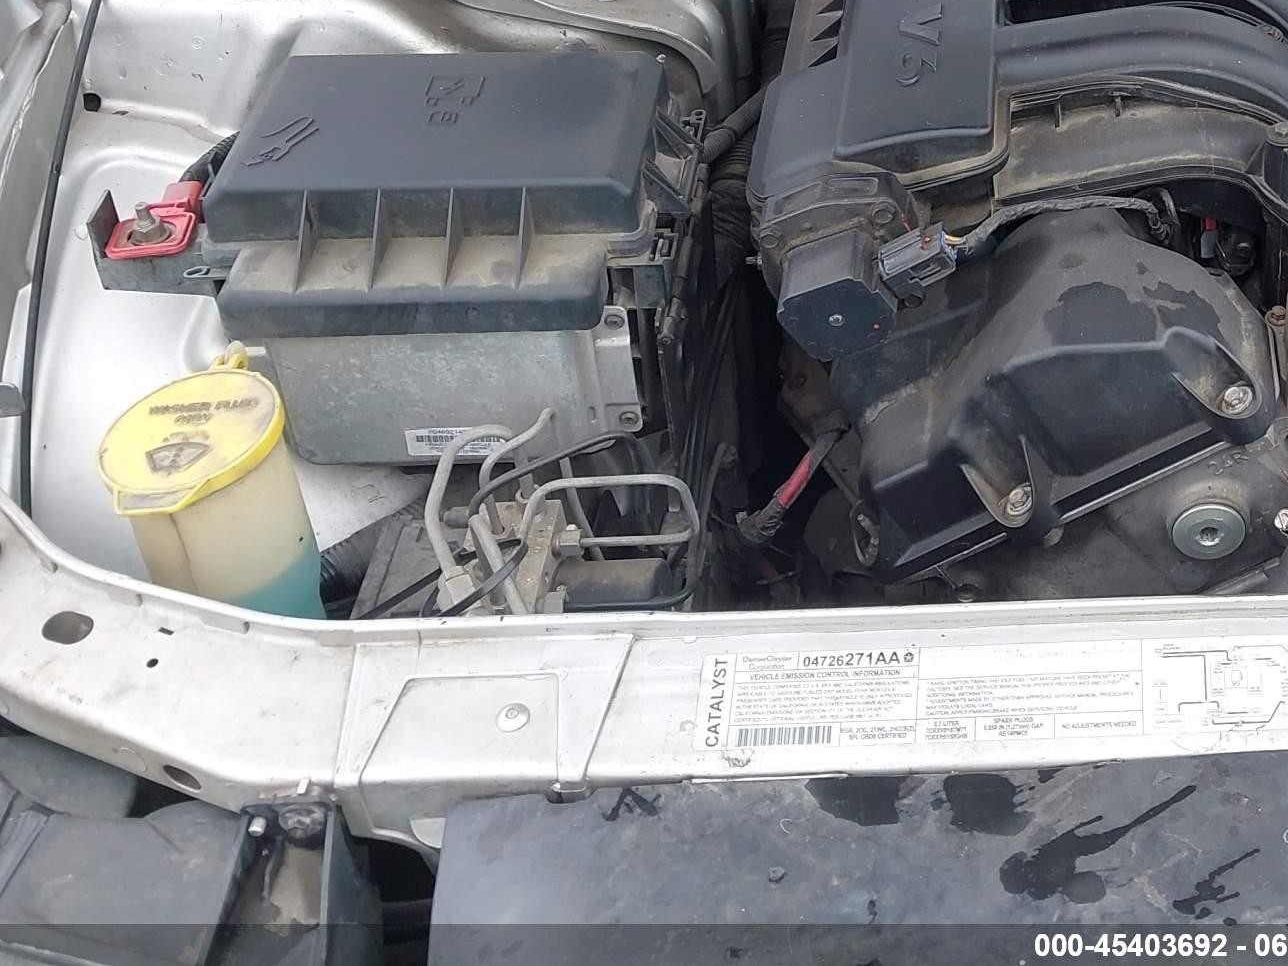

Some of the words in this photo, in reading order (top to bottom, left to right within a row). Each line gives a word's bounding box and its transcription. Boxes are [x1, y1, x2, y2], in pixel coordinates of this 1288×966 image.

[896, 2, 943, 87] V6
[749, 663, 785, 672] Corporation
[803, 651, 901, 668] 04726271AA
[852, 669, 900, 677] INFORMATION
[705, 658, 729, 748] CATALYST
